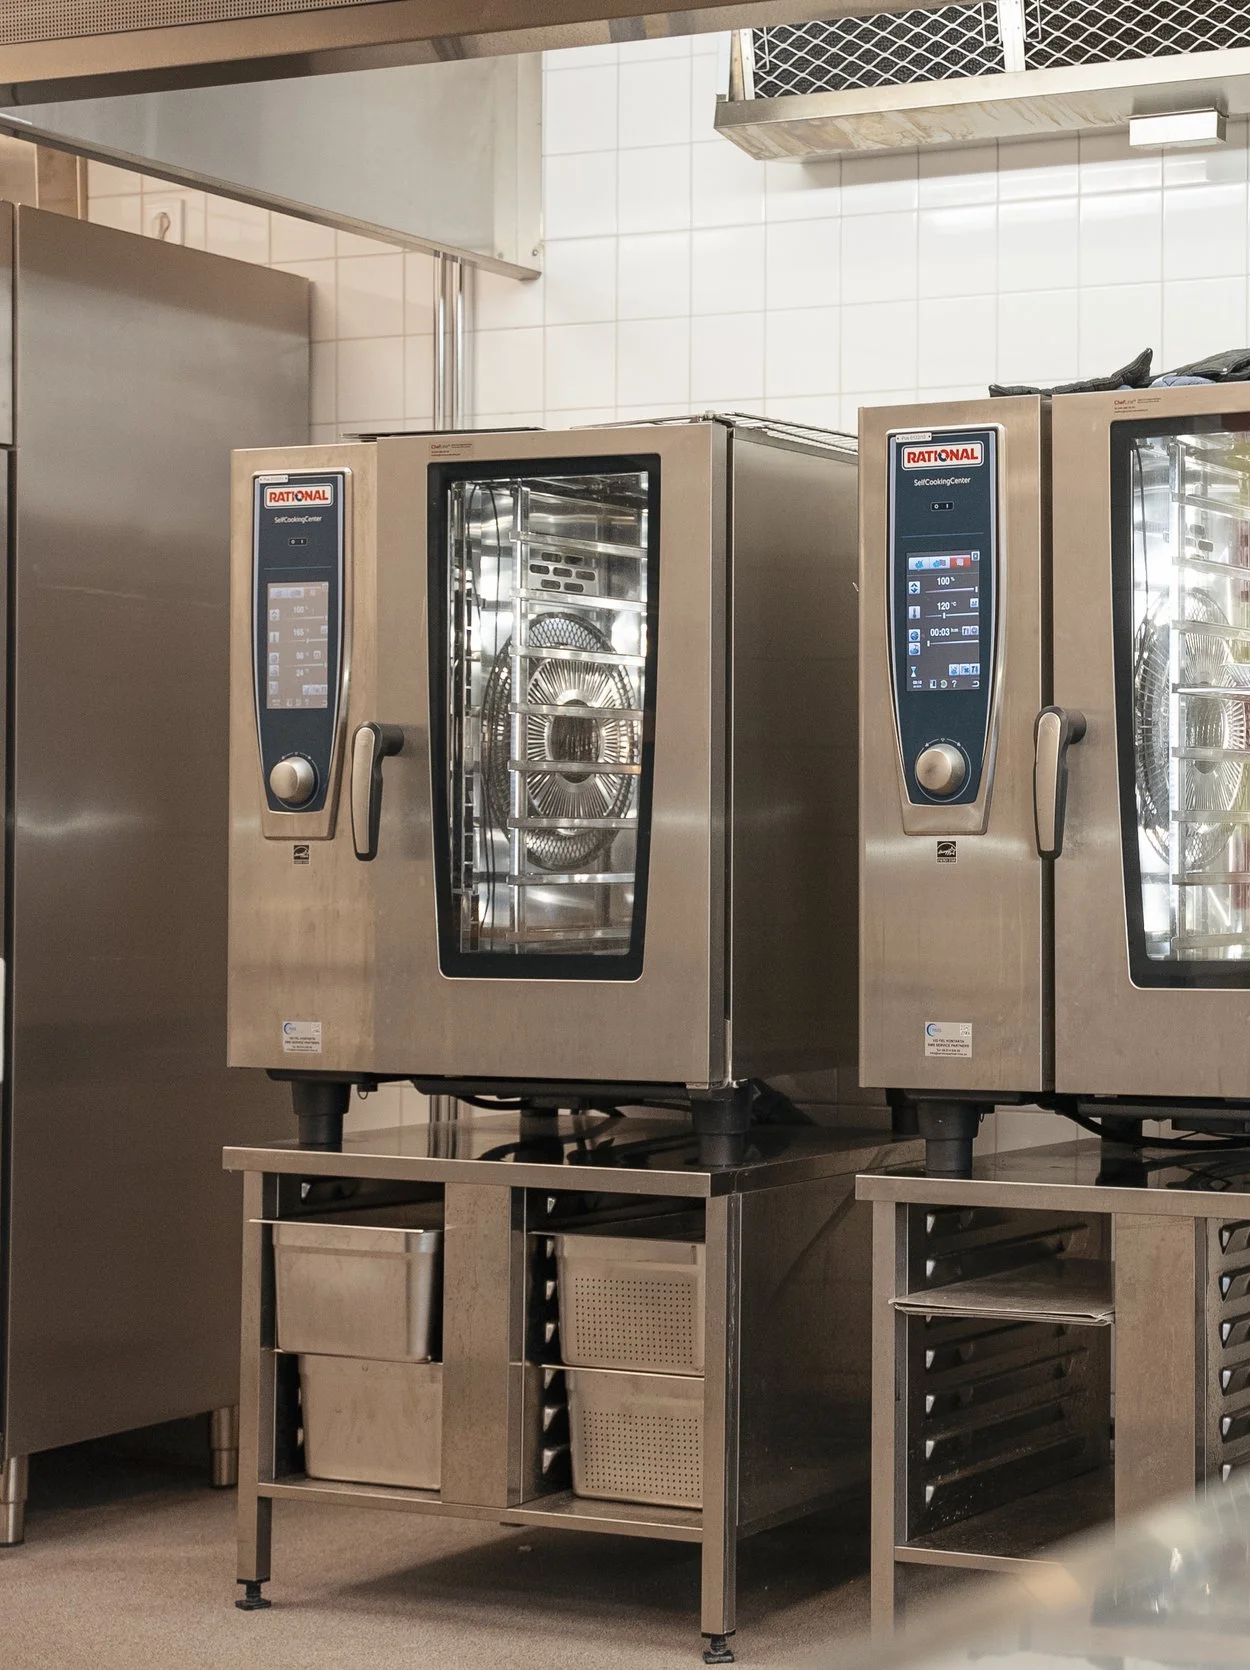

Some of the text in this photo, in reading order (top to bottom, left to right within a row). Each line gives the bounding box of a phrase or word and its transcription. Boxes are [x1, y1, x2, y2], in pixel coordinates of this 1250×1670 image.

[907, 448, 978, 464] RATIONAL
[914, 477, 971, 487] SelfCookingCenter
[269, 490, 329, 503] RATIONAL
[274, 516, 322, 524] SelfCookingCenter
[937, 577, 950, 586] 100
[937, 602, 950, 610] 120
[930, 628, 950, 637] 00:03
